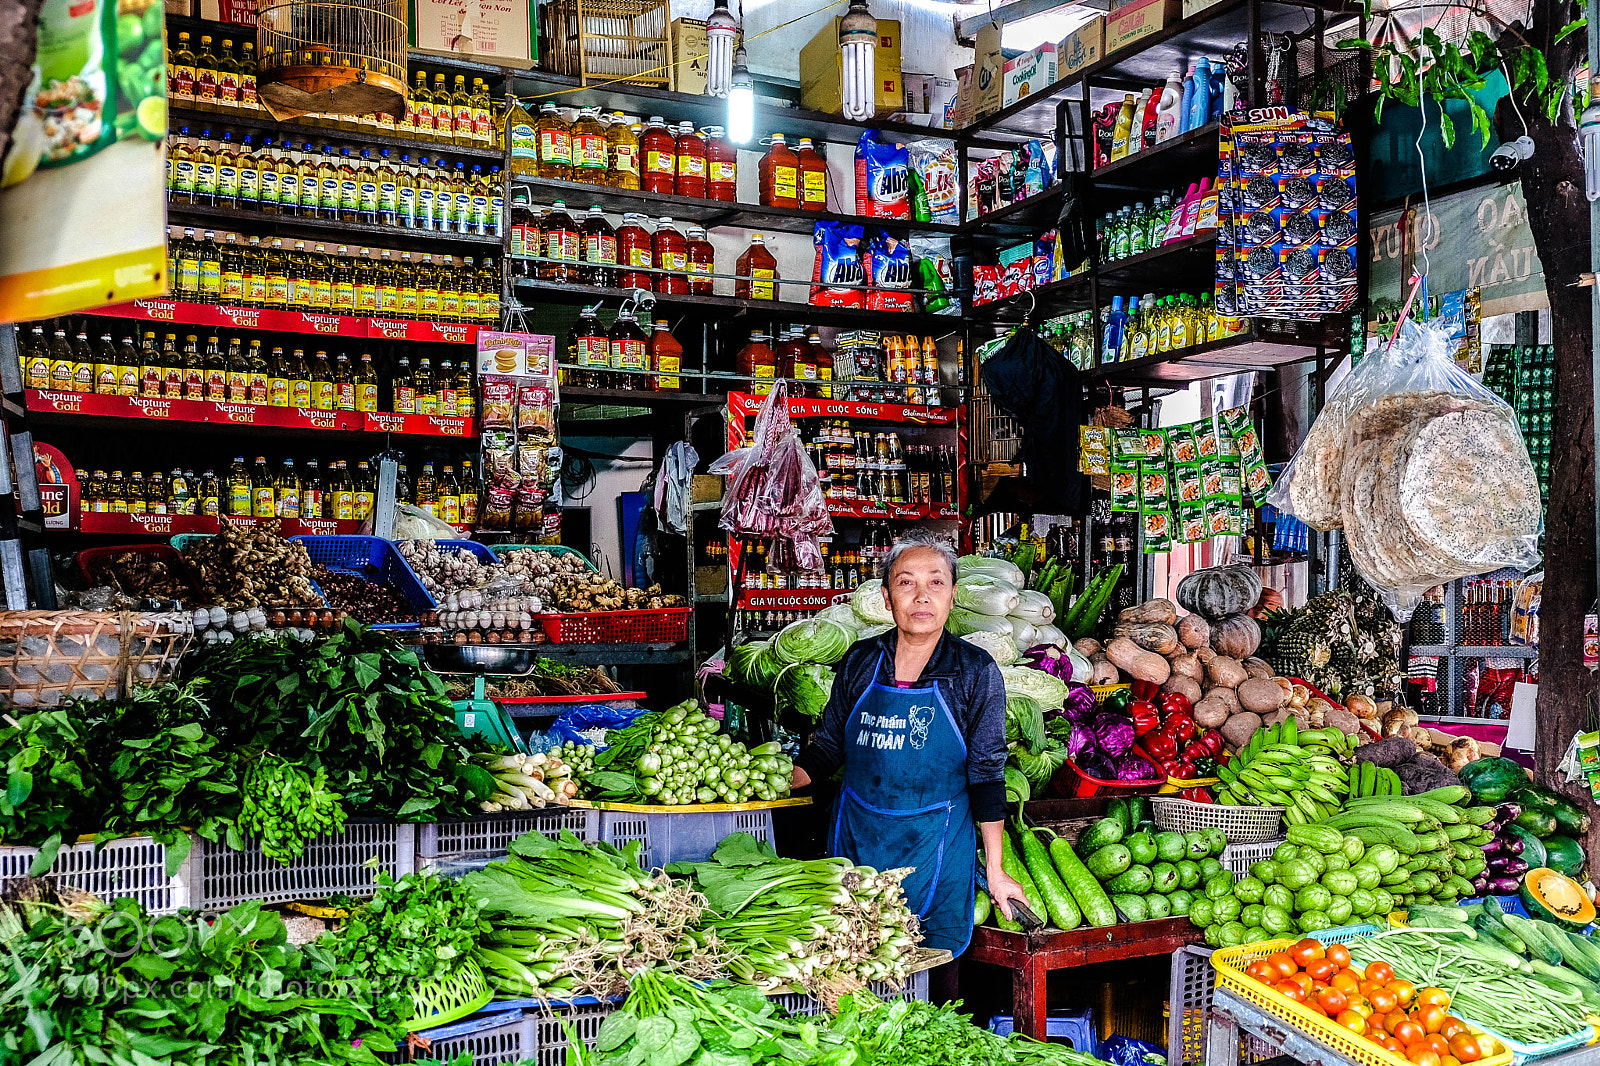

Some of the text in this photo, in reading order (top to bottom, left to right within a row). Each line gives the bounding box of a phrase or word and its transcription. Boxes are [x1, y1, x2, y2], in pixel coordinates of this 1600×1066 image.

[1249, 107, 1289, 122] SUN
[885, 258, 910, 282] Ab
[134, 299, 175, 314] Neptune
[219, 306, 260, 319] Neptune
[148, 308, 174, 320] Gold
[301, 313, 340, 326] Neptune
[233, 316, 258, 327] Gold
[314, 322, 338, 333] Gold
[383, 329, 406, 339] Gold
[431, 322, 467, 335] Neptune
[443, 332, 466, 342] Gold
[38, 390, 83, 405] Neptune
[129, 396, 171, 411] Neptune
[53, 401, 80, 412] Gold
[142, 407, 169, 418] Gold
[215, 402, 256, 416] Neptune
[791, 405, 806, 414] GIA
[811, 405, 821, 415] VỊ
[827, 404, 850, 415] CUỘC
[856, 404, 878, 415] SỐNG
[228, 412, 254, 423] Gold
[298, 407, 337, 421] Neptune
[367, 412, 405, 426] Neptune
[311, 417, 335, 428] Gold
[380, 422, 403, 432] Gold
[429, 415, 464, 429] Neptune
[440, 426, 463, 436] Gold
[894, 507, 920, 516] Cholimex
[130, 514, 172, 526] Neptune
[299, 518, 338, 529] Neptune
[144, 523, 170, 533] Gold
[750, 595, 827, 607] GIA VỊ CUỘC SỐNG
[871, 730, 905, 750] TOÀN
